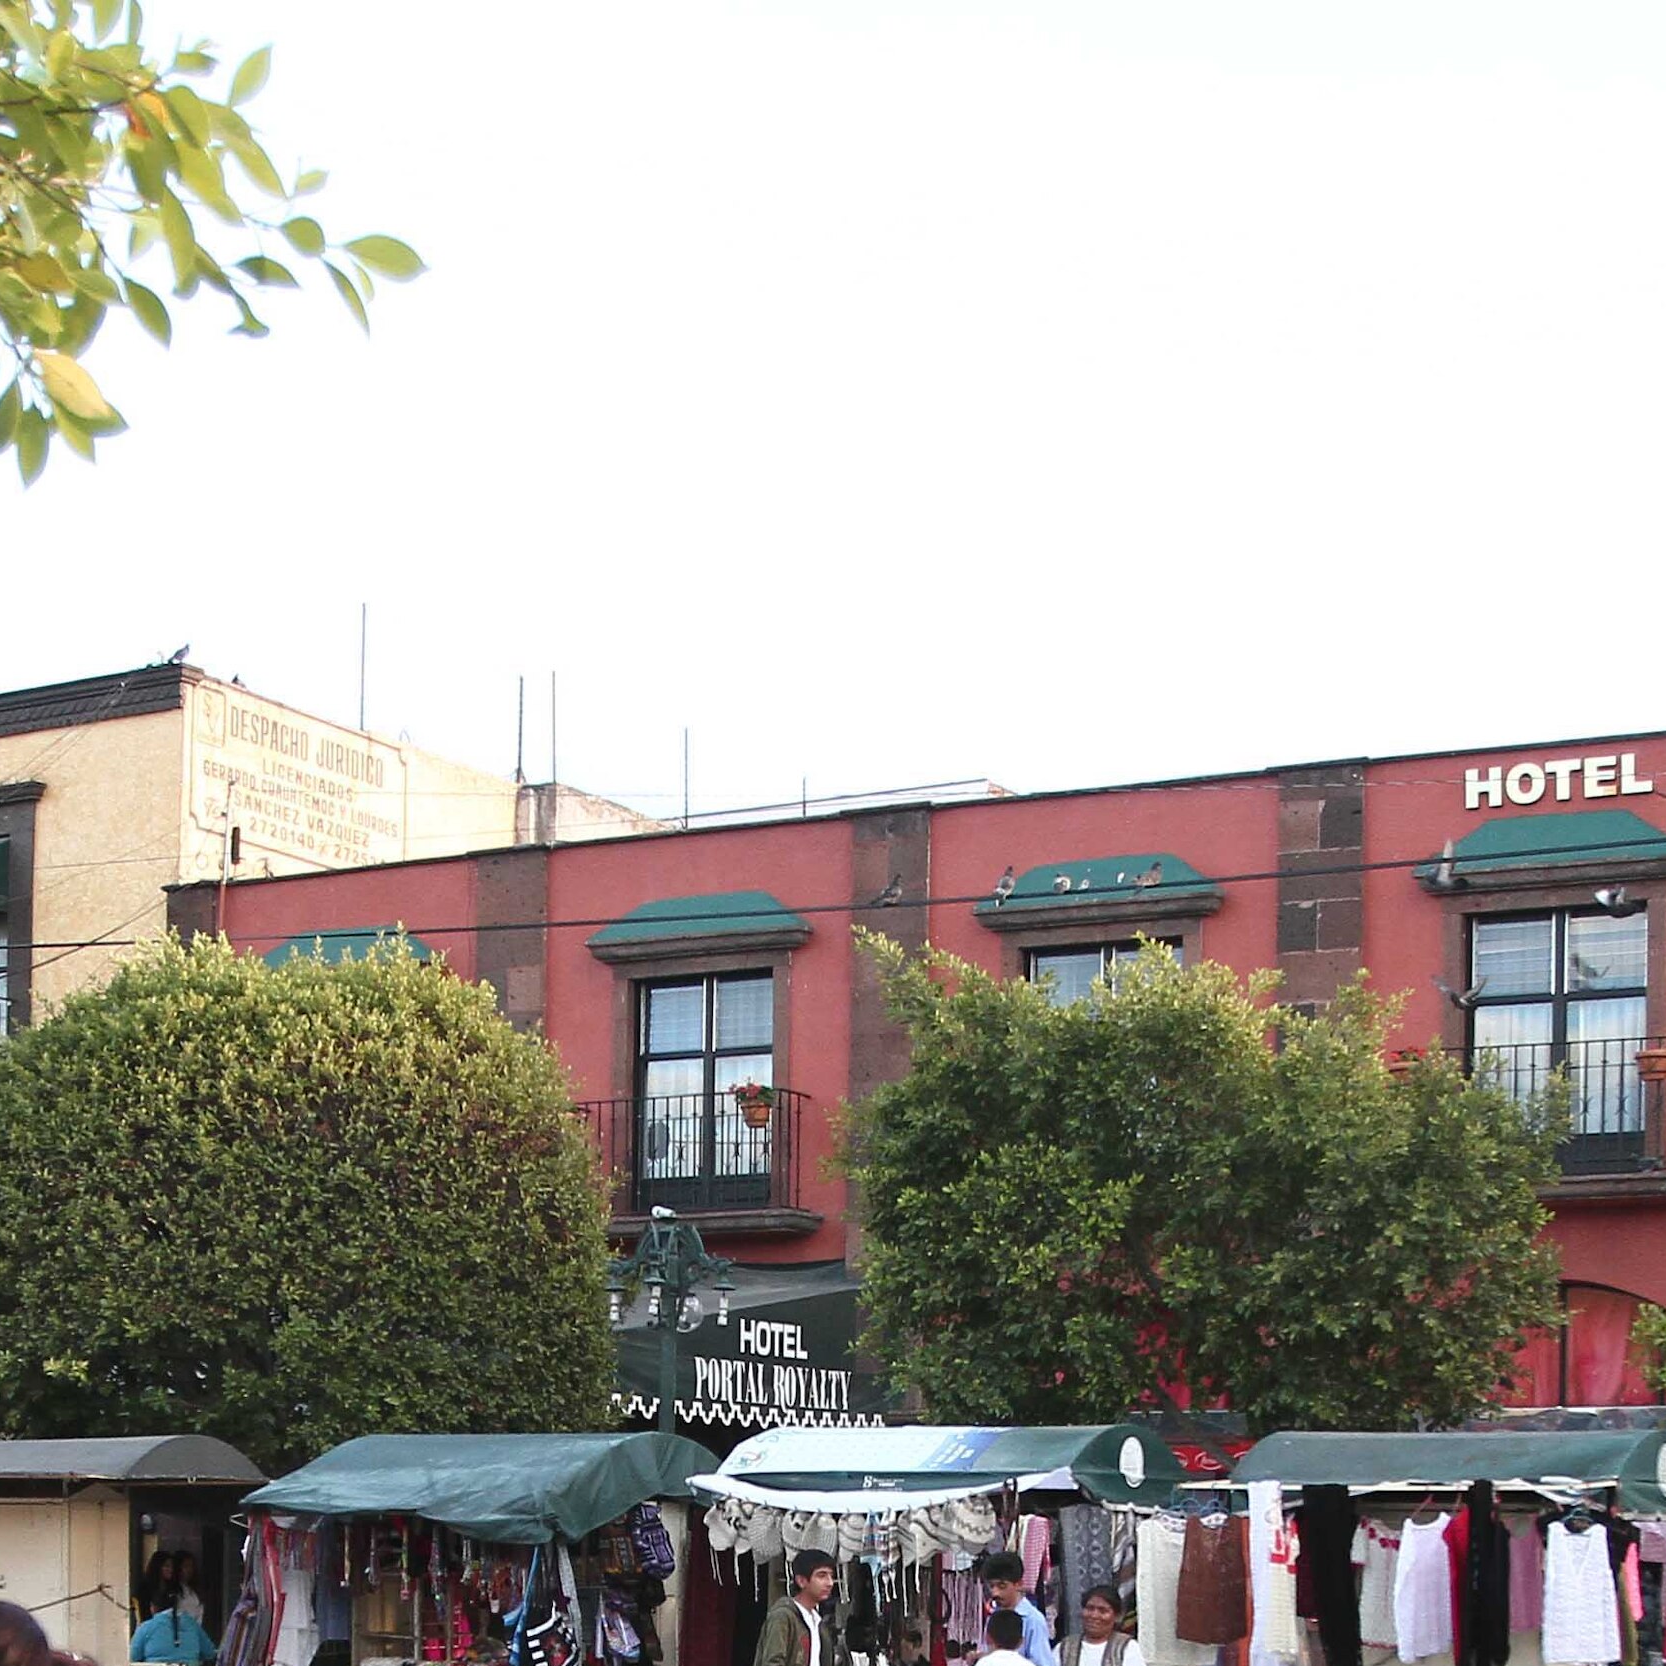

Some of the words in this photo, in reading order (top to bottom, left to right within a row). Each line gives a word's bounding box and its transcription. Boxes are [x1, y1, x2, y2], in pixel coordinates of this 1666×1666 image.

[230, 705, 308, 762] DESPACHO
[316, 737, 384, 788] JURIDICO
[262, 757, 355, 803] LICENCIADOS
[1464, 753, 1654, 810] HOTEL
[234, 791, 301, 825] SANCHEZ
[307, 814, 370, 848] VAZQUEZ
[249, 816, 315, 849] 2720140
[339, 804, 347, 820] Y
[350, 807, 399, 838] LOURDES
[739, 1318, 808, 1360] HOTEL
[694, 1356, 768, 1409] PORTAL
[773, 1364, 852, 1413] ROYALTY
